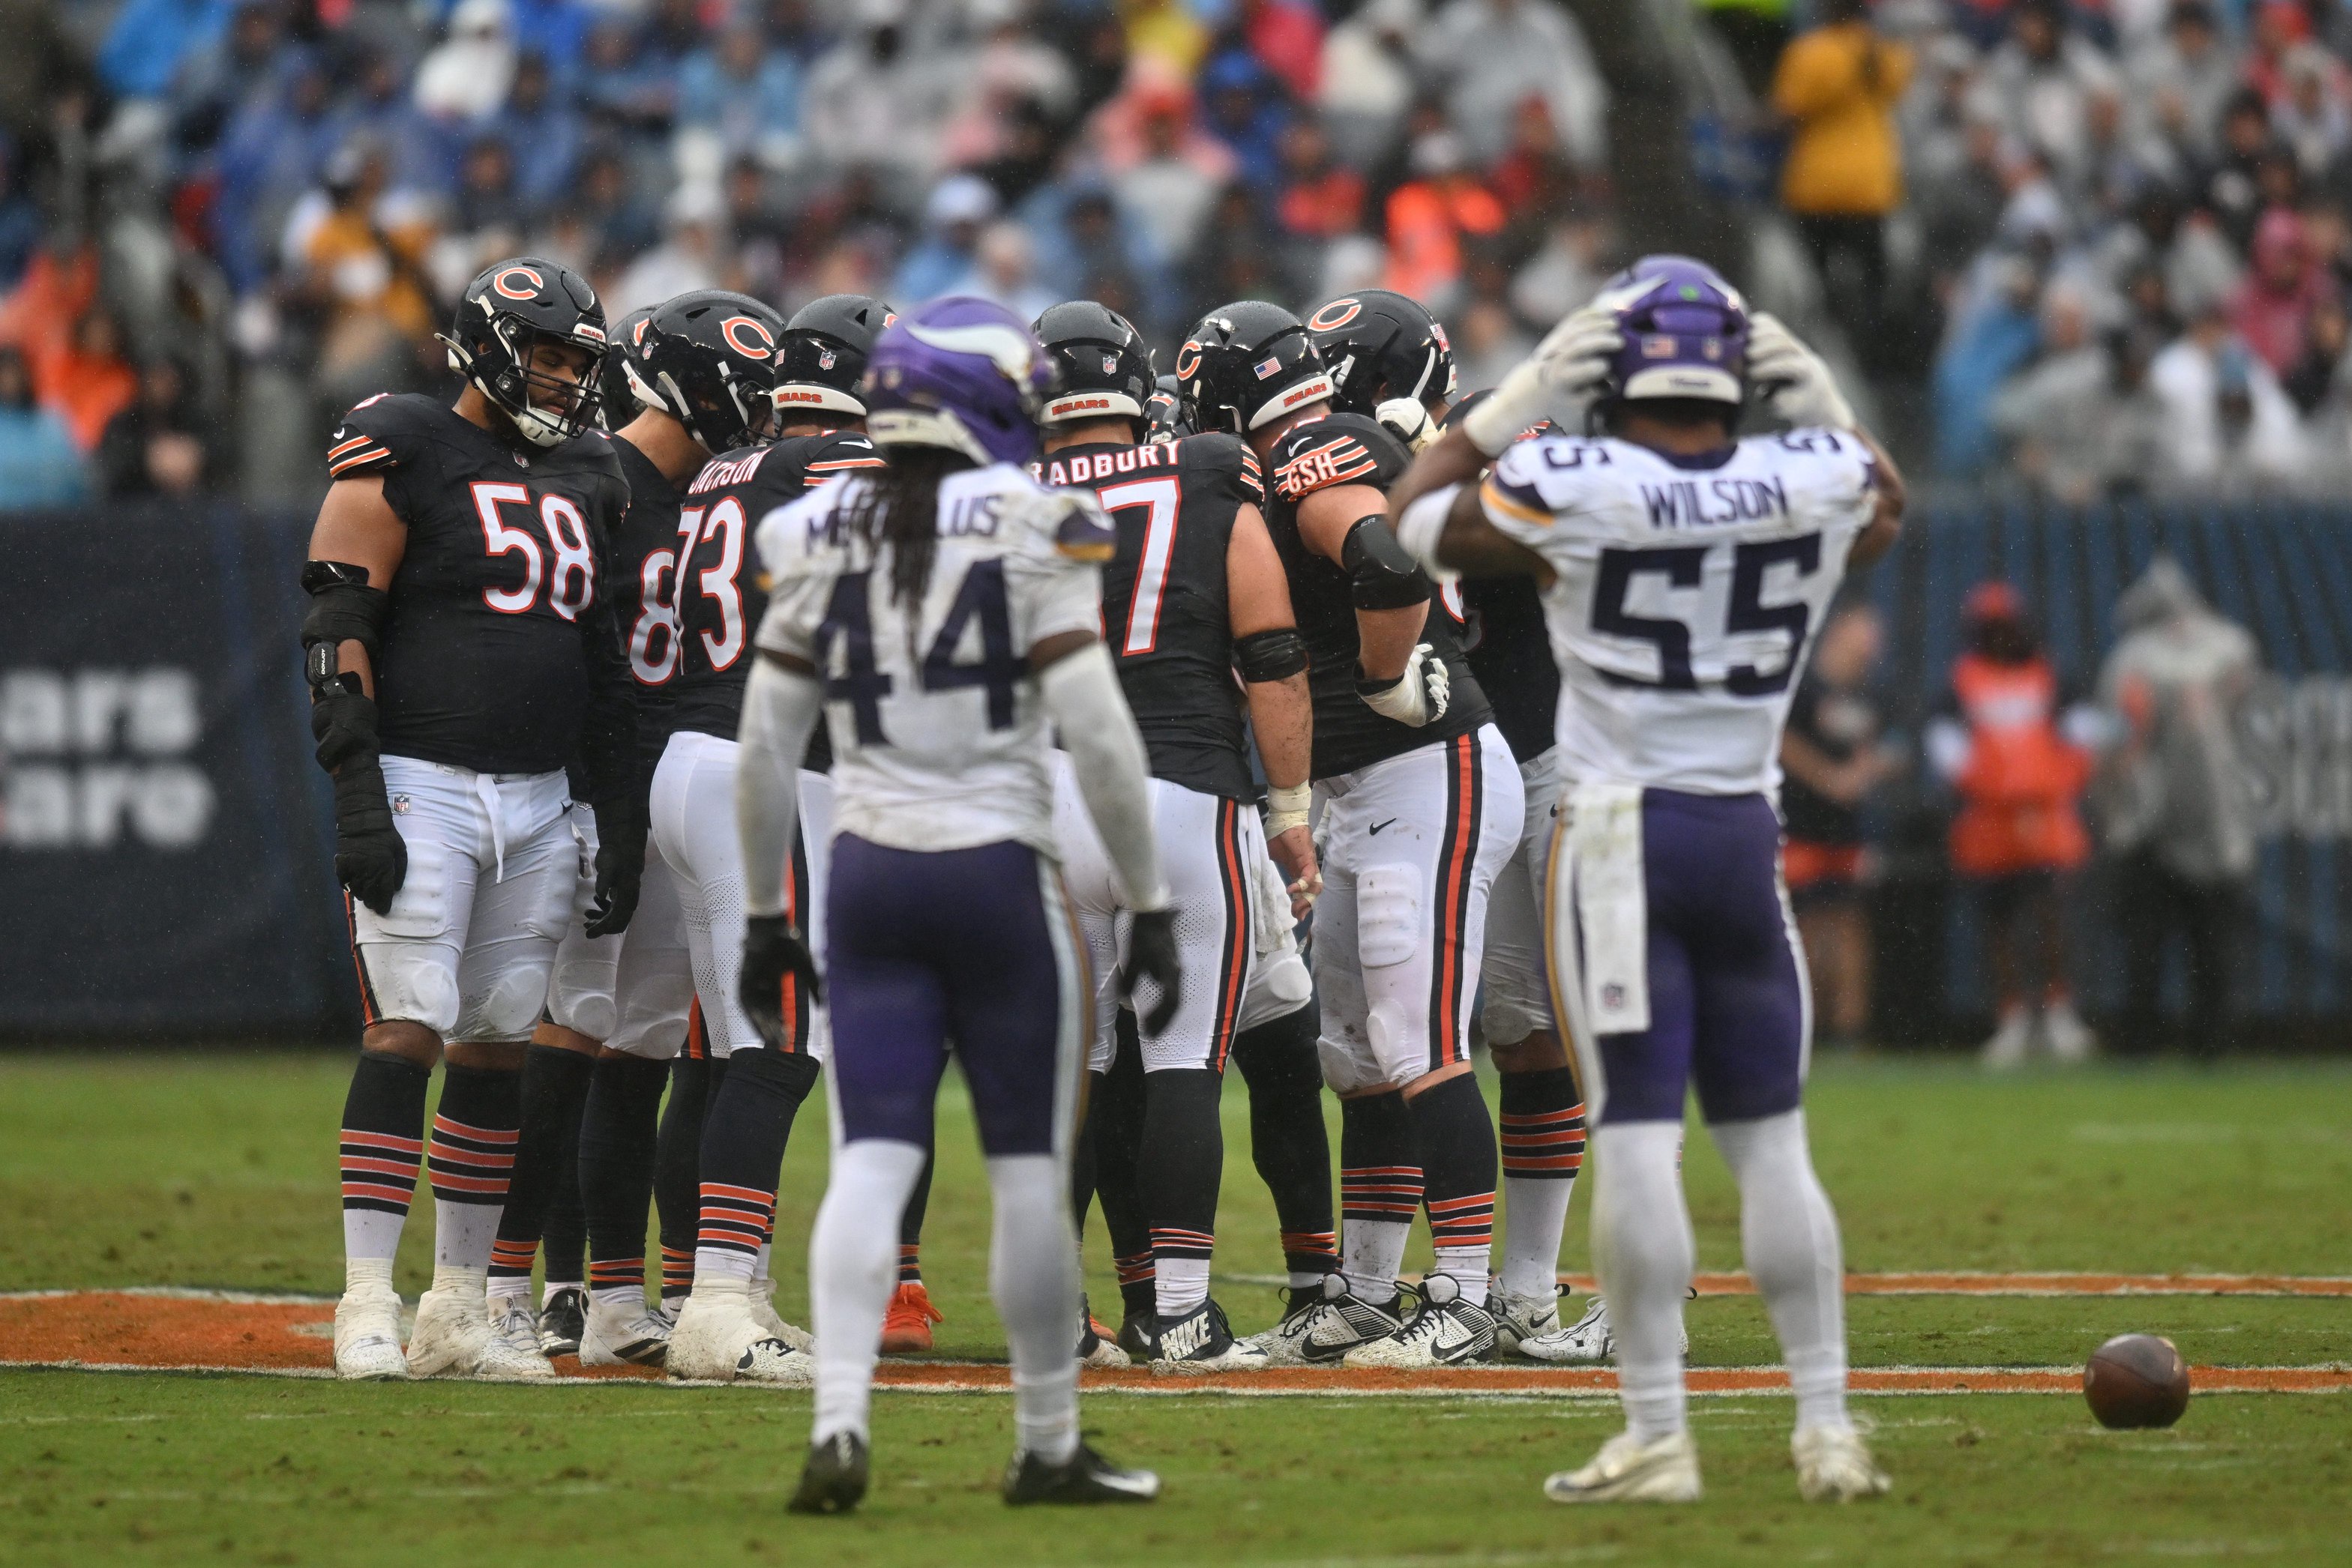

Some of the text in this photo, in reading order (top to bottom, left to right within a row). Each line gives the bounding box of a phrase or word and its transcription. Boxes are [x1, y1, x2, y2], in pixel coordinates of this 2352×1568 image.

[777, 392, 823, 404] BEARS
[1052, 399, 1110, 416] BEARS
[1284, 382, 1328, 408] BEARS
[688, 447, 775, 495] JACKSON
[1030, 439, 1182, 487] RADBURY
[1287, 449, 1338, 495] GSH
[1640, 475, 1790, 528] WILSON
[468, 480, 597, 623] 58
[1096, 474, 1182, 657] 7
[676, 495, 747, 675] 73
[1592, 531, 1823, 694] 55
[814, 555, 1030, 749] 44
[1159, 1310, 1212, 1362] NIKE
[1467, 1338, 1494, 1358] FORCE
